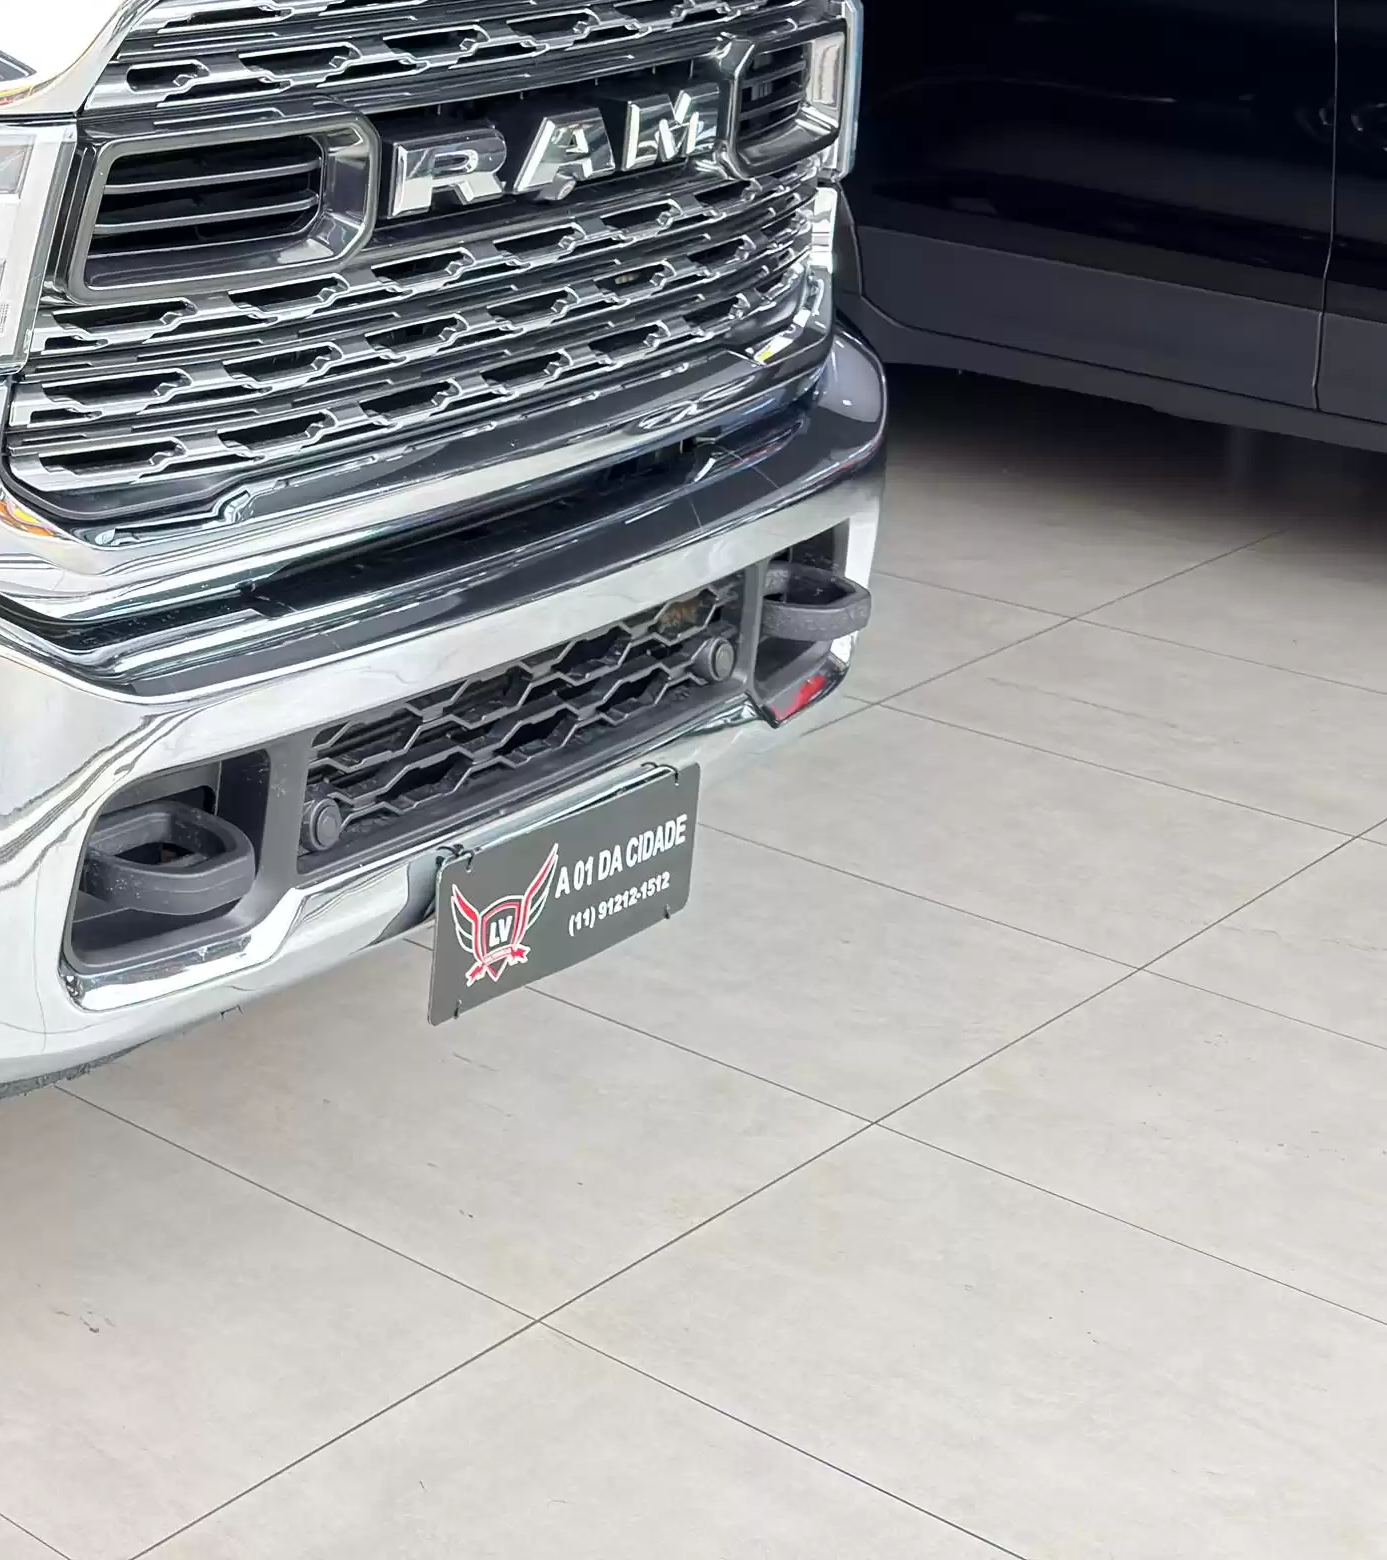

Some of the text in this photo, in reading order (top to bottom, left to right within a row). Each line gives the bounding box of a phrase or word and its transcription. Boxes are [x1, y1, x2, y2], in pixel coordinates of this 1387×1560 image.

[388, 83, 721, 218] RAM
[555, 813, 688, 898] A 01 DA CIDADE
[489, 915, 514, 947] LV
[568, 872, 671, 937] (11) 91212-1512
